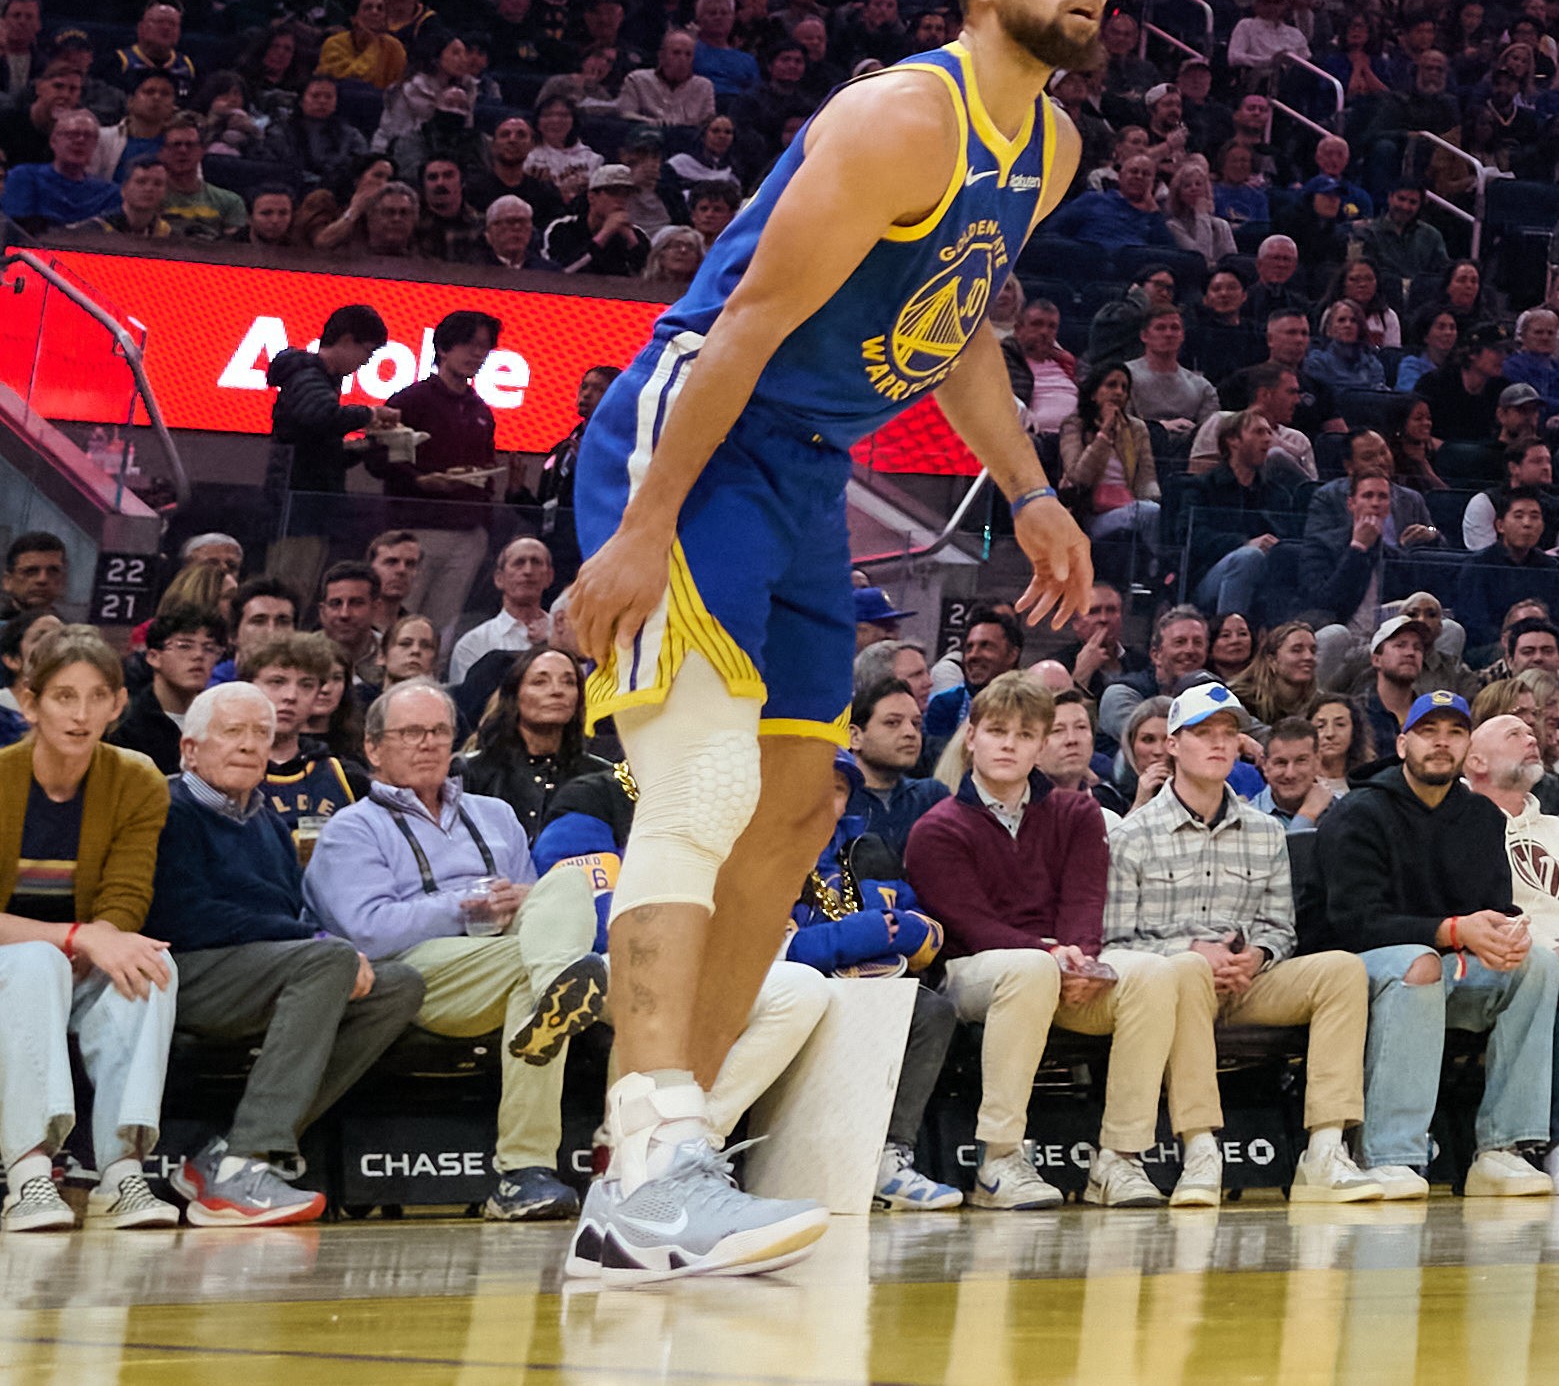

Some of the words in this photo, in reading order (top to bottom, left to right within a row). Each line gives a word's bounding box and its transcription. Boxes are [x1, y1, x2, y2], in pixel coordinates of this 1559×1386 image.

[217, 315, 531, 409] Aoe
[106, 558, 146, 584] 22
[101, 593, 135, 620] 21
[360, 1152, 486, 1177] CHASE
